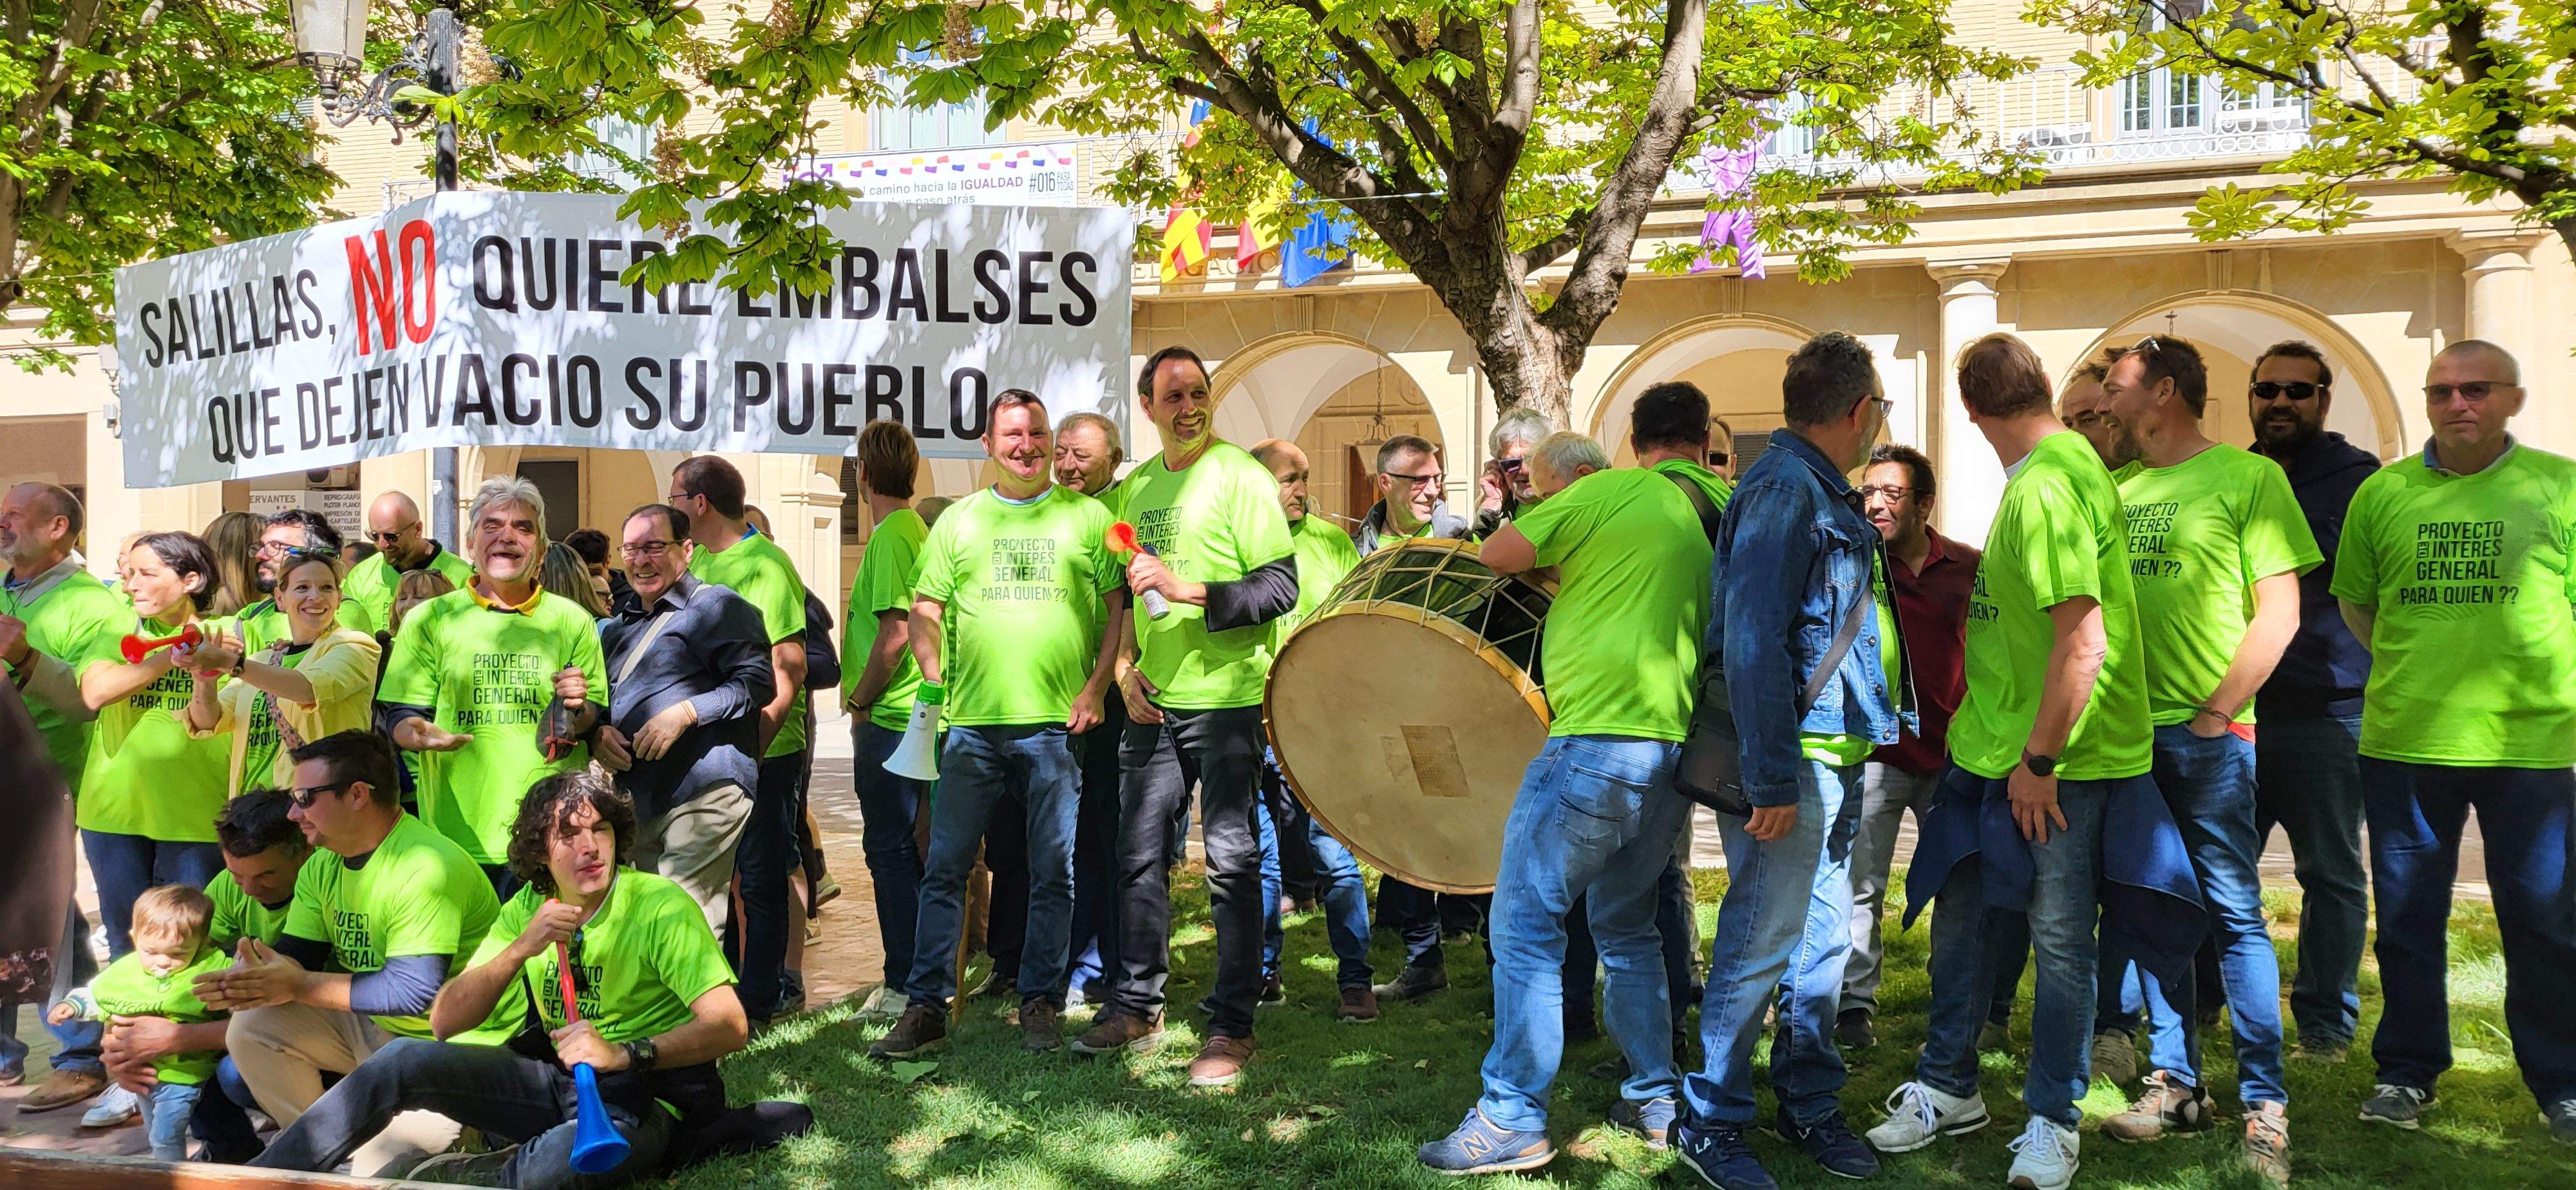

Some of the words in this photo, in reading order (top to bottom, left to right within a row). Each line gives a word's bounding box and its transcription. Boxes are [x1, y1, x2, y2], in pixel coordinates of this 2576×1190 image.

[869, 184, 910, 195] camino
[914, 182, 943, 193] hacia
[947, 180, 957, 191] la
[961, 176, 1023, 190] IGUALDAD
[1029, 171, 1055, 193] #016
[947, 193, 975, 205] atrás
[140, 269, 336, 368] SALILLAS,
[345, 220, 436, 356] NO
[209, 387, 284, 464] QUE
[296, 363, 408, 451] DEJEN
[421, 352, 602, 428] VACIO
[625, 357, 707, 431] SU
[734, 361, 988, 441] PUEBLO
[250, 495, 296, 504] ERVANTES
[1139, 506, 1182, 525] PROYECTO
[2124, 502, 2179, 518] ROYECTO
[1145, 521, 1181, 540] INTERES
[2418, 520, 2505, 540] PROYECTO
[993, 538, 1055, 551] PROYECTO
[2129, 535, 2166, 554] ERAL
[2432, 538, 2503, 558] INTERES
[1005, 551, 1055, 565] INTERES
[993, 566, 1054, 582] GENERAL
[2164, 560, 2183, 578] ??
[2416, 559, 2500, 580] GENERAL
[981, 586, 1010, 602] PARA
[1014, 586, 1051, 601] QUIEN
[1054, 588, 1068, 603] ??
[2400, 586, 2438, 605] PARA
[2443, 585, 2494, 604] QUIEN
[2499, 585, 2519, 605] ??
[474, 653, 542, 669] PROYECTO
[487, 670, 541, 686] INTERES
[130, 694, 162, 710] PARA
[473, 687, 541, 704] GENERAL
[458, 710, 492, 726] PARA
[498, 709, 537, 724] QUIEN
